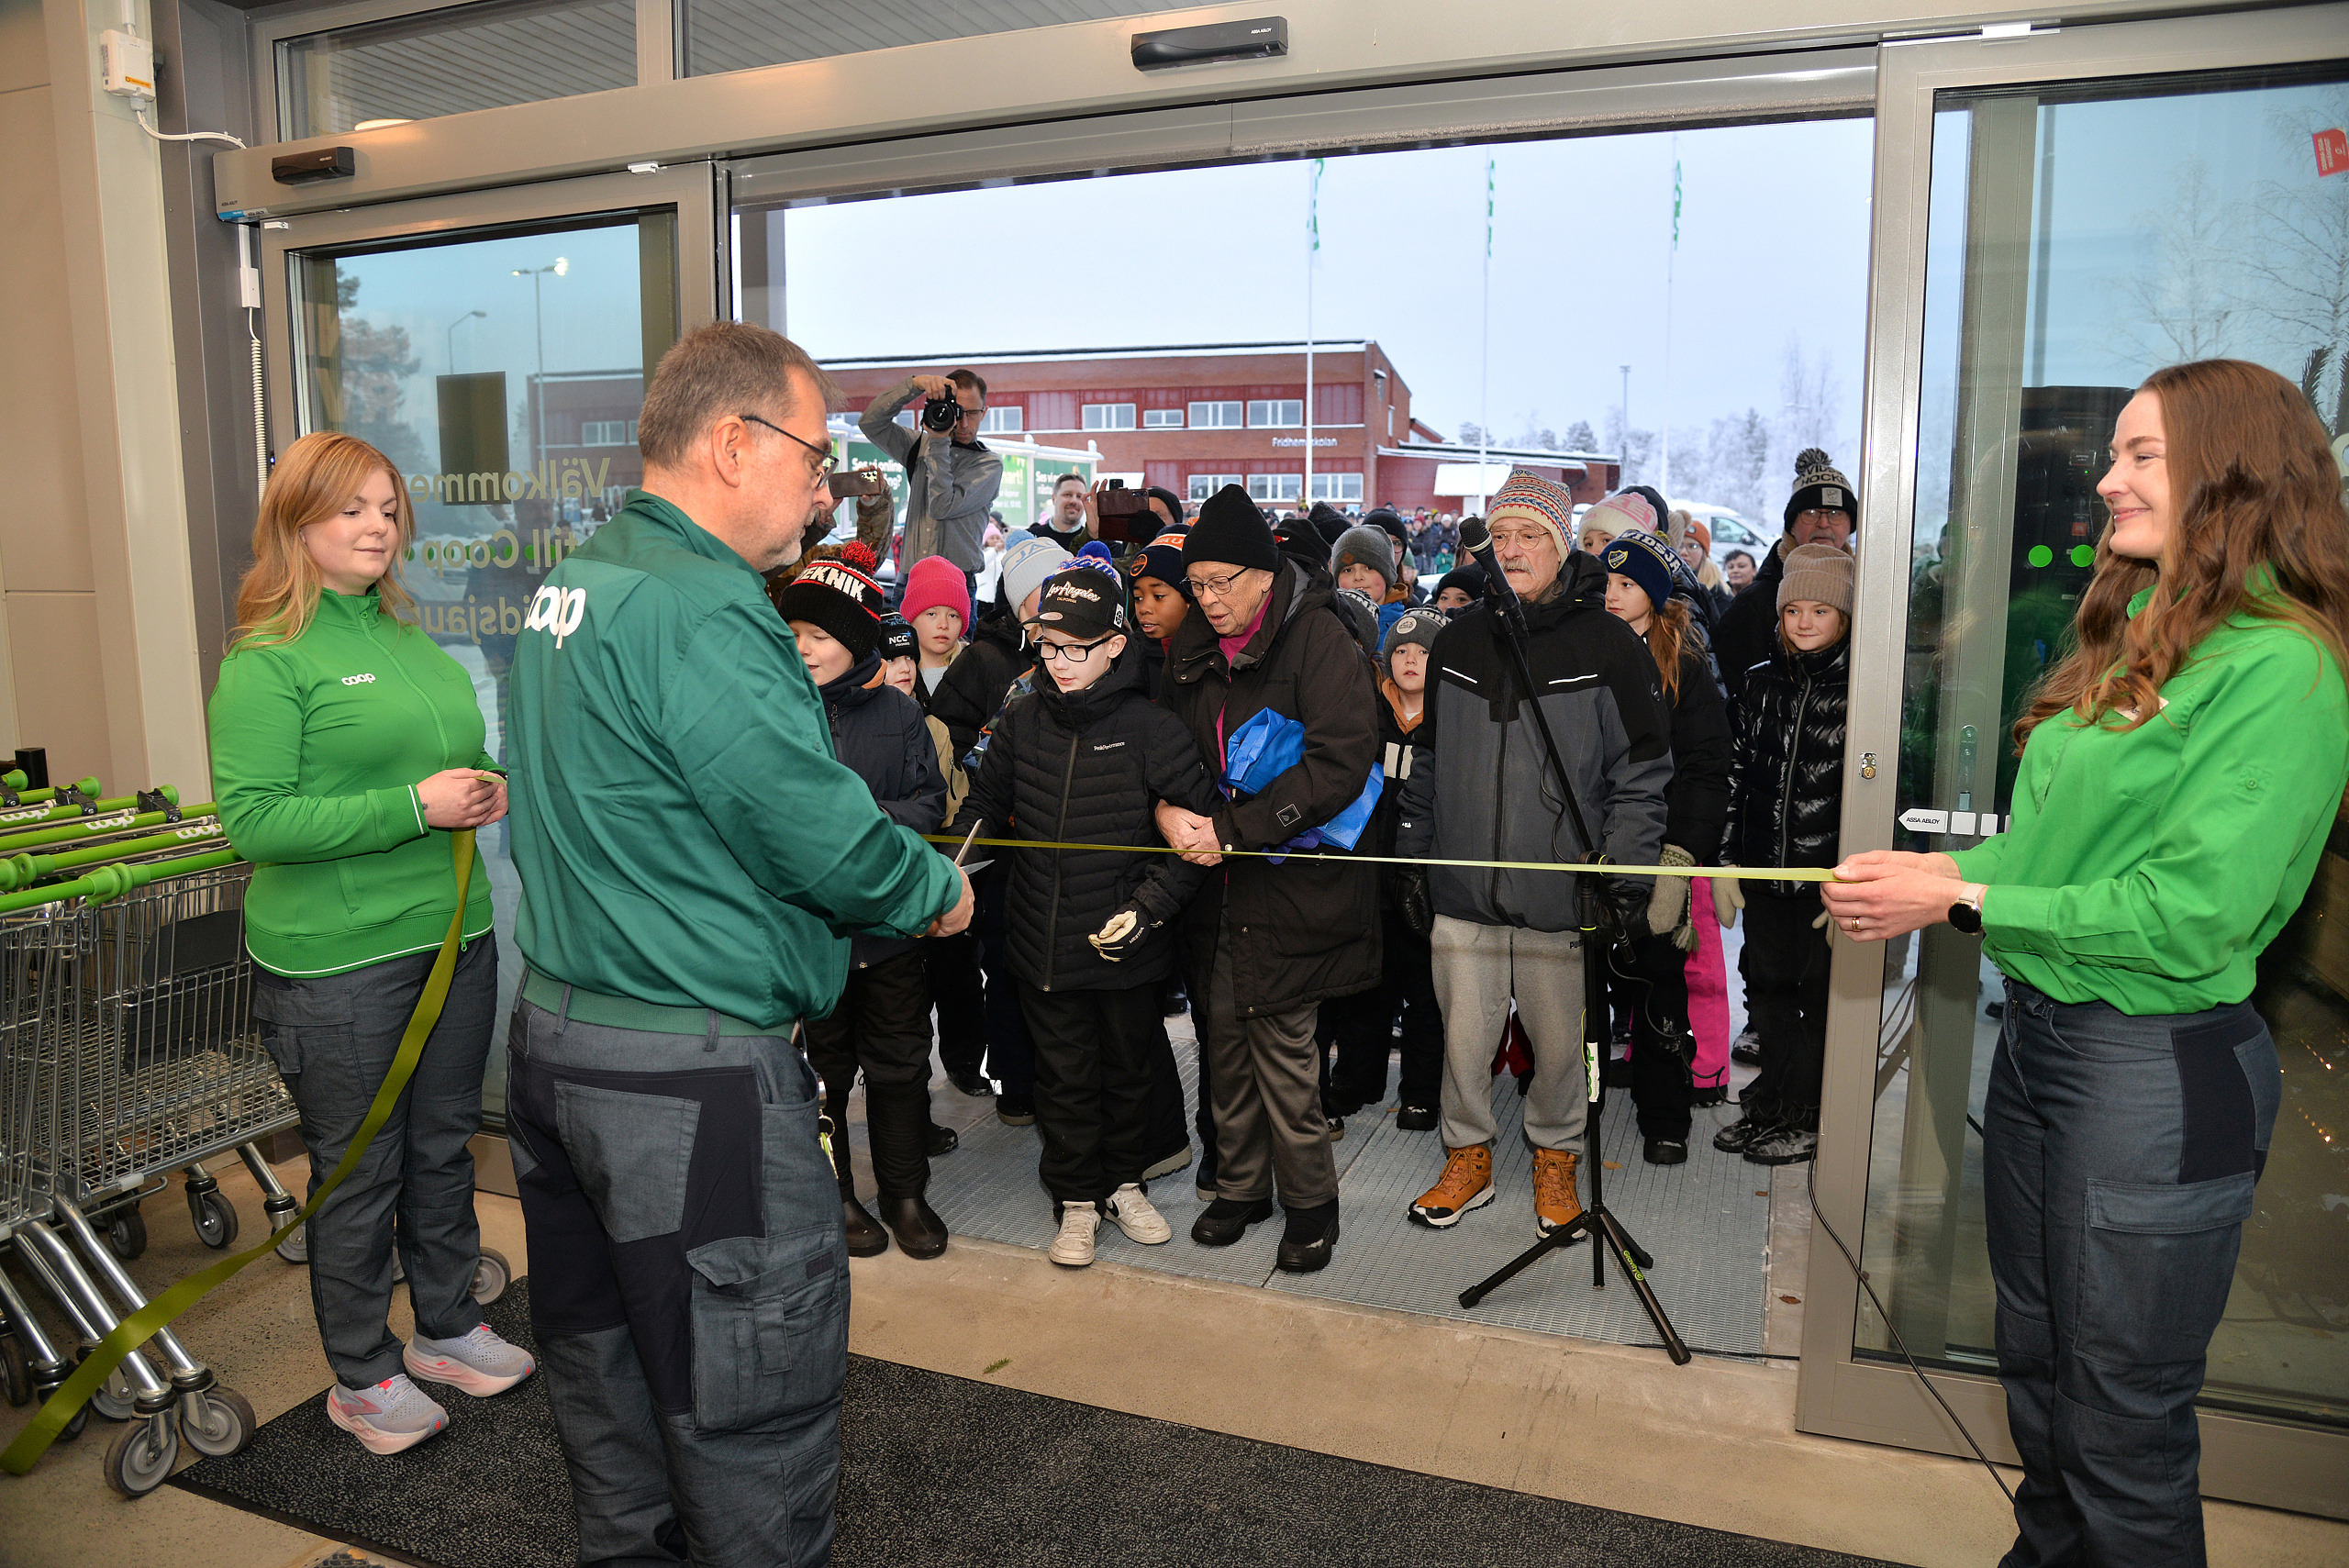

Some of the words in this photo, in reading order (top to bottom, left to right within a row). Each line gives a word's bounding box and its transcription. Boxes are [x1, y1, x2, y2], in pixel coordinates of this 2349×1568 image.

[1272, 437, 1338, 447] Fridhemkolan
[1801, 473, 1851, 487] HOCKE
[1620, 531, 1682, 574] VIDSJA
[1059, 580, 1101, 603] Angeles
[888, 635, 908, 645] NCC
[341, 673, 376, 686] coop
[0, 808, 50, 823] coop
[84, 815, 136, 830] coop
[175, 823, 224, 840] coop
[1623, 1250, 1641, 1273] Gravity
